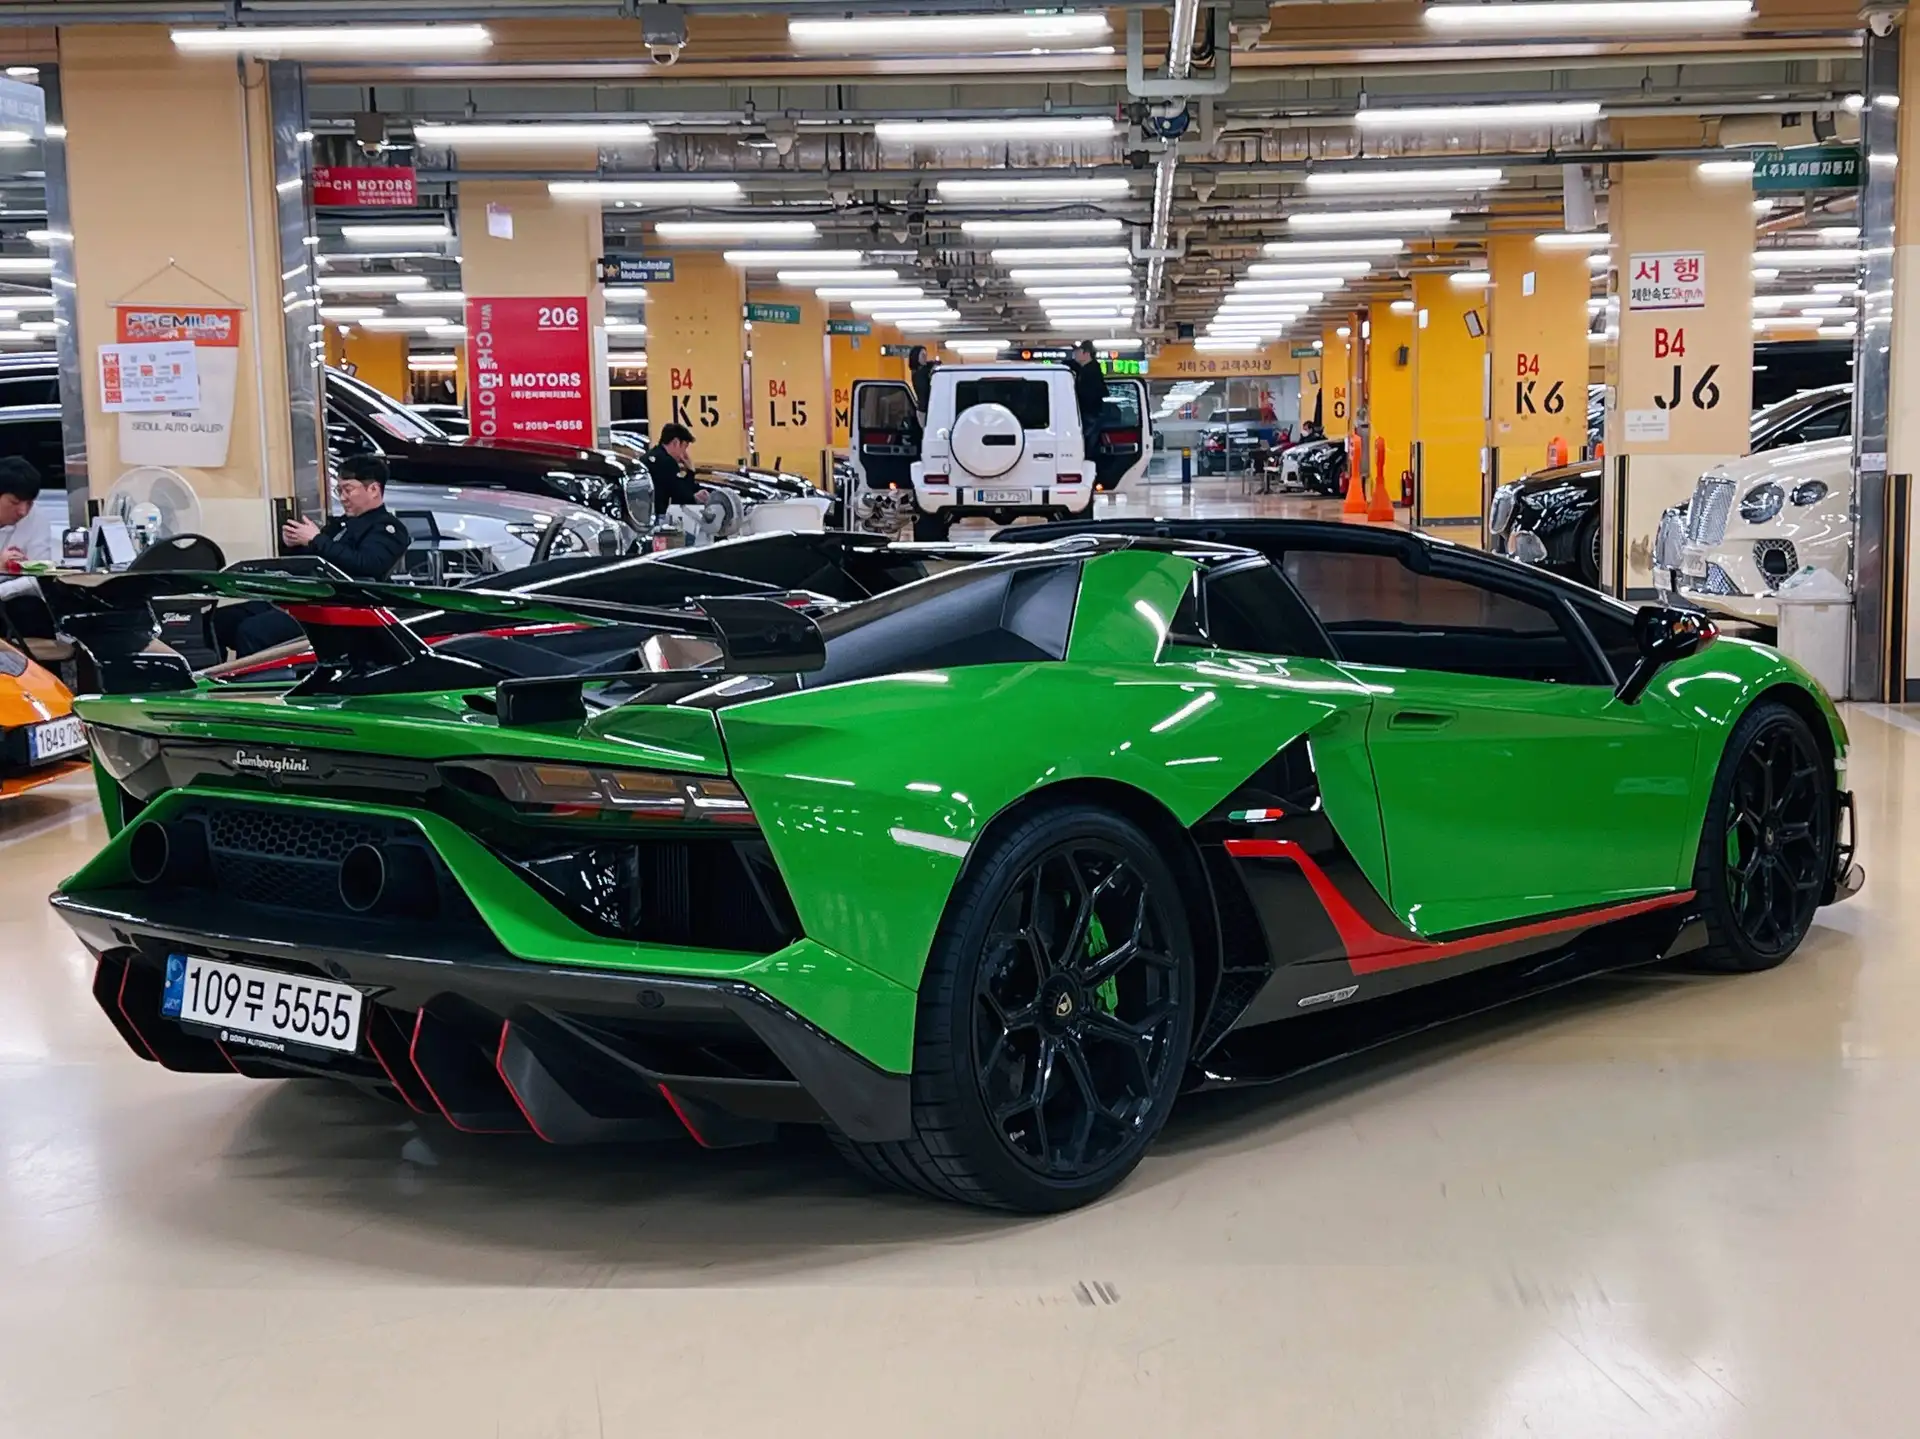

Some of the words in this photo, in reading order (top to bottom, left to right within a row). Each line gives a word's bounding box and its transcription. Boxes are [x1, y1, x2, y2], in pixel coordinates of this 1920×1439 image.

[333, 180, 352, 190] CH
[357, 180, 412, 191] MOTORS
[538, 307, 578, 325] 206
[1654, 328, 1686, 359] B4
[1517, 353, 1540, 376] B4
[510, 373, 581, 387] MOTORS
[670, 368, 693, 390] B4
[769, 380, 787, 397] B4
[1654, 365, 1720, 410] J6
[834, 389, 849, 403] B4
[1516, 381, 1564, 414] K6
[770, 401, 807, 427] L5
[131, 422, 162, 432] SEOUL
[165, 422, 188, 432] AUTO
[190, 422, 224, 433] GALLERY
[233, 750, 309, 773] Lamborghini
[272, 982, 353, 1041] 5555
